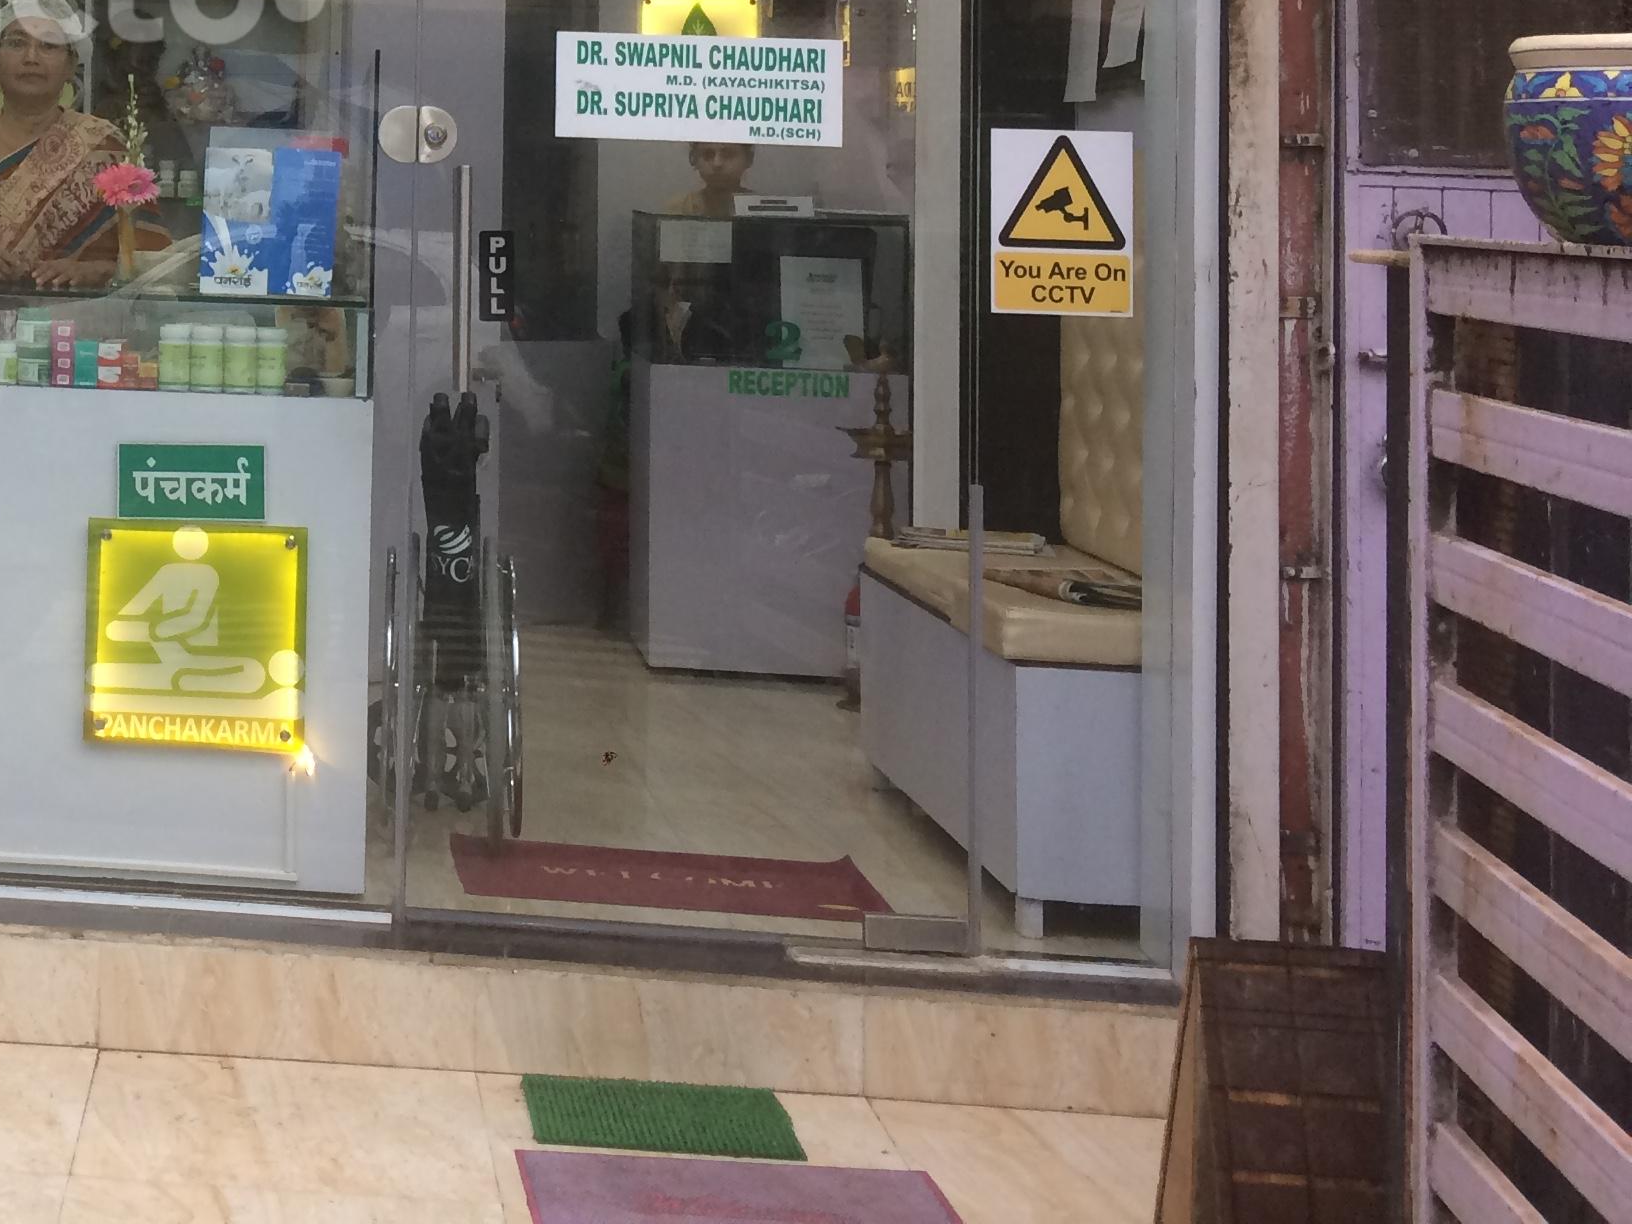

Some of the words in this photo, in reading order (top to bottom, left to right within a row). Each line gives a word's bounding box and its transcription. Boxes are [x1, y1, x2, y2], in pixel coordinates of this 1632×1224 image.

[576, 39, 608, 65] DR.
[614, 41, 703, 69] SWAPNIL
[708, 44, 826, 74] CHAUDHARI
[666, 75, 697, 87] M.D.
[702, 76, 826, 94] (KAYACHIKITSA)
[576, 89, 608, 116] DR.
[614, 91, 699, 119] SUPRIYA
[705, 94, 822, 124] CHAUDHARI
[489, 236, 507, 315] PULL
[1000, 260, 1041, 279] You
[1048, 262, 1088, 280] Are
[1094, 263, 1127, 282] On
[1031, 284, 1096, 305] CCTV
[764, 321, 802, 361] 2
[727, 370, 850, 398] RECEPTION
[132, 456, 252, 506] पंचकर्म
